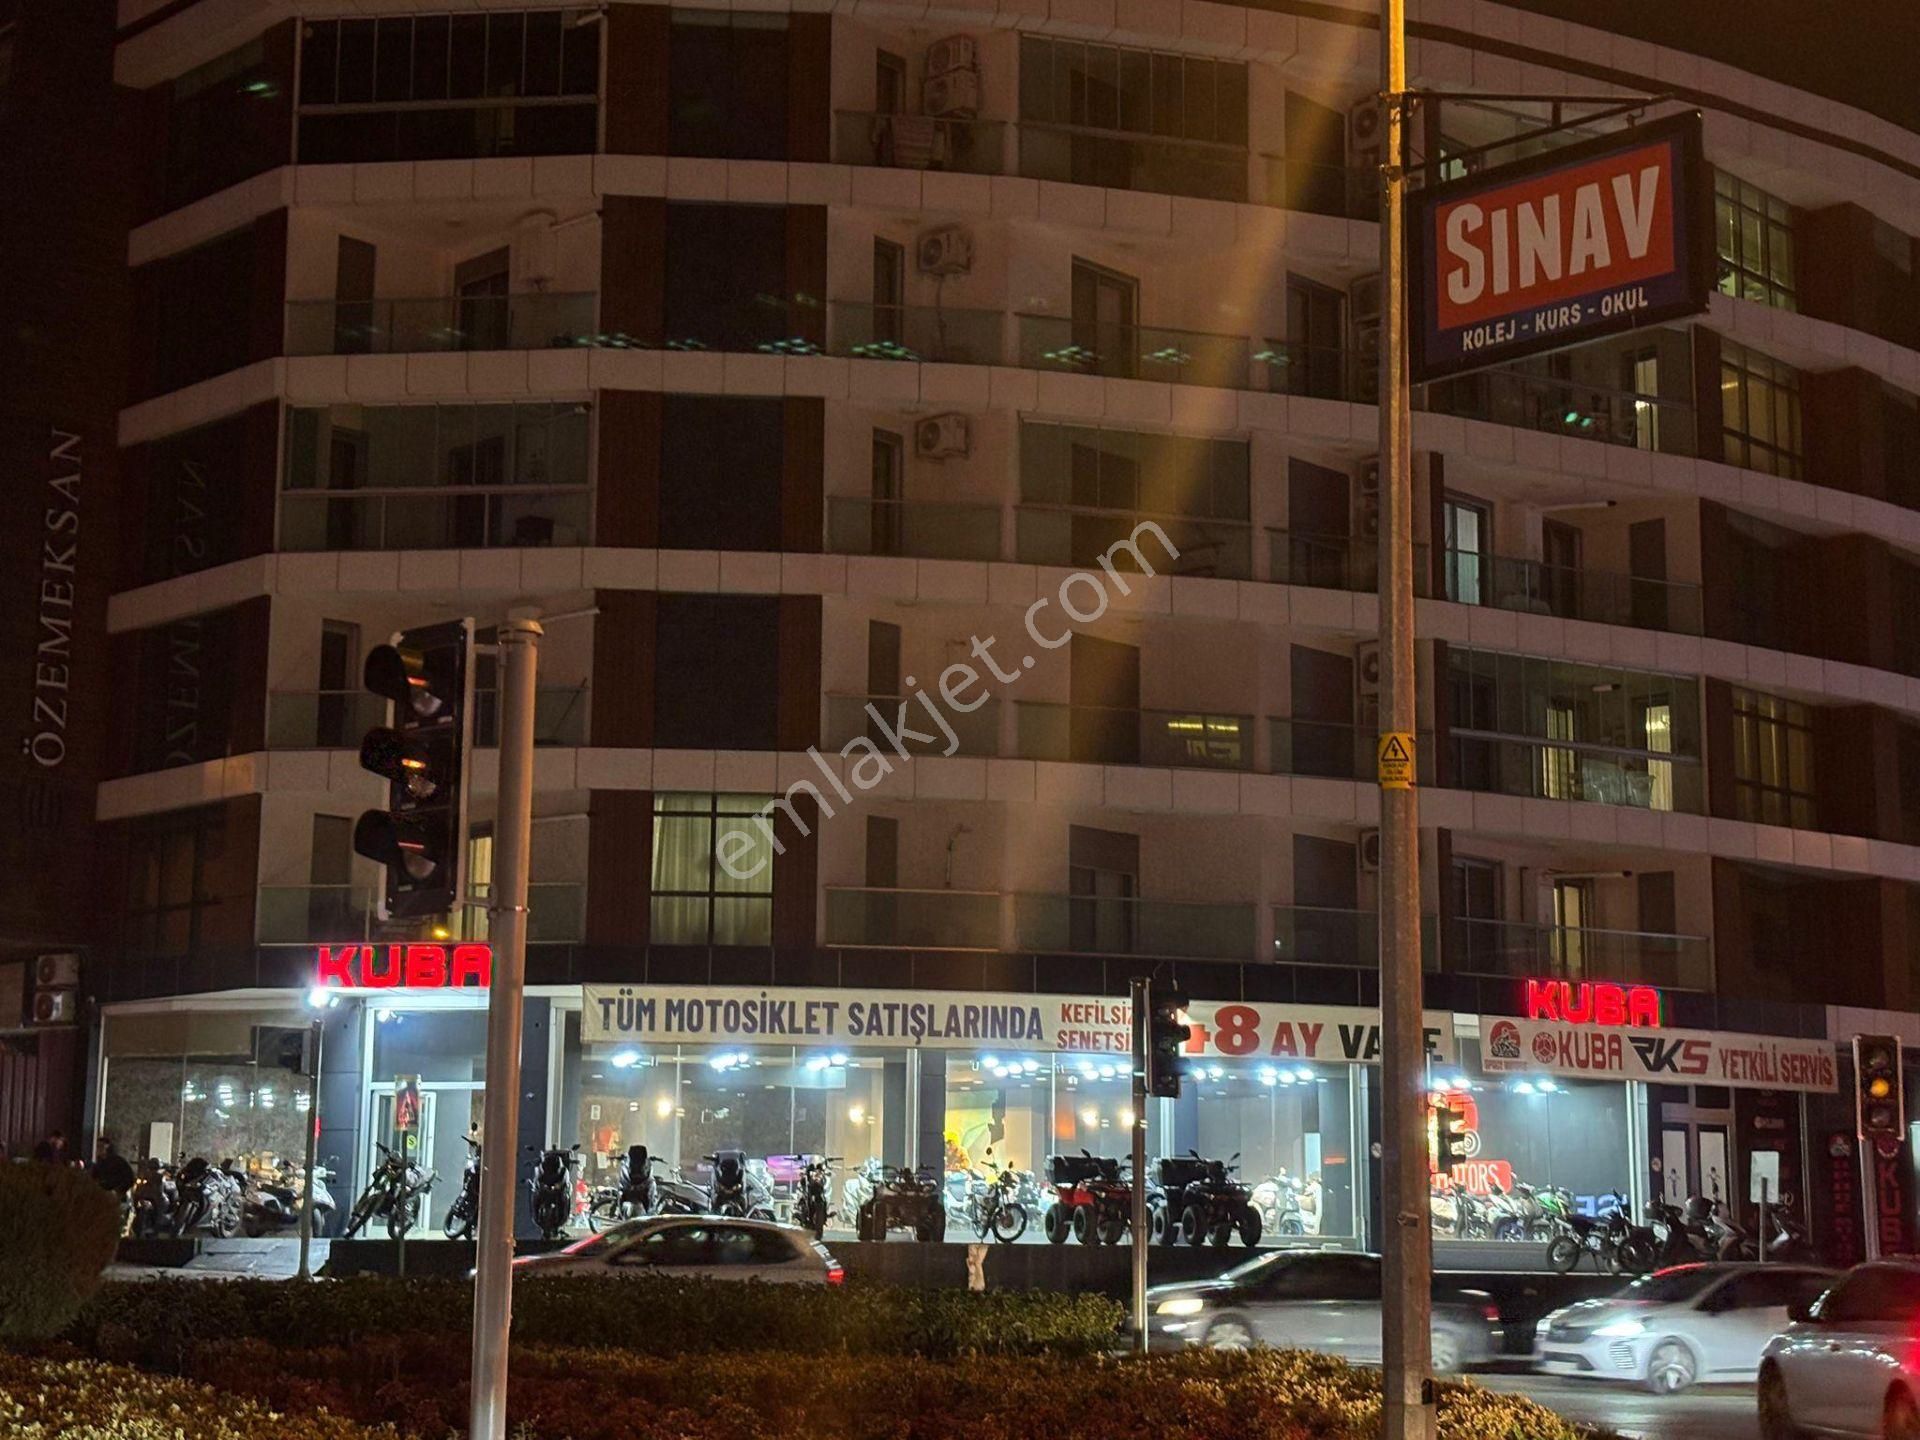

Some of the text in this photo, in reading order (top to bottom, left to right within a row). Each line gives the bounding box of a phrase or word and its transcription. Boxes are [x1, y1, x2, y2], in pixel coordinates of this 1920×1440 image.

[1446, 166, 1660, 305] SINAV
[1463, 320, 1516, 351] KOLEJ
[1535, 304, 1582, 333] KURS
[1601, 287, 1649, 316] OKUL
[23, 427, 82, 768] ÖZEMEKSAN
[317, 944, 492, 988] KUBA
[598, 988, 1043, 1045] TÜM MOTOSİKLET SATIŞLARINDA
[1527, 979, 1661, 1028] KUBA
[1057, 1027, 1132, 1051] SENETSİ
[1271, 1022, 1324, 1057] AY
[1338, 1024, 1443, 1061] VAE
[1558, 1031, 1623, 1070] KUBA
[1628, 1036, 1711, 1074] RKS
[1719, 1042, 1778, 1083] YETKİLİ
[1781, 1046, 1833, 1086] SERVİS
